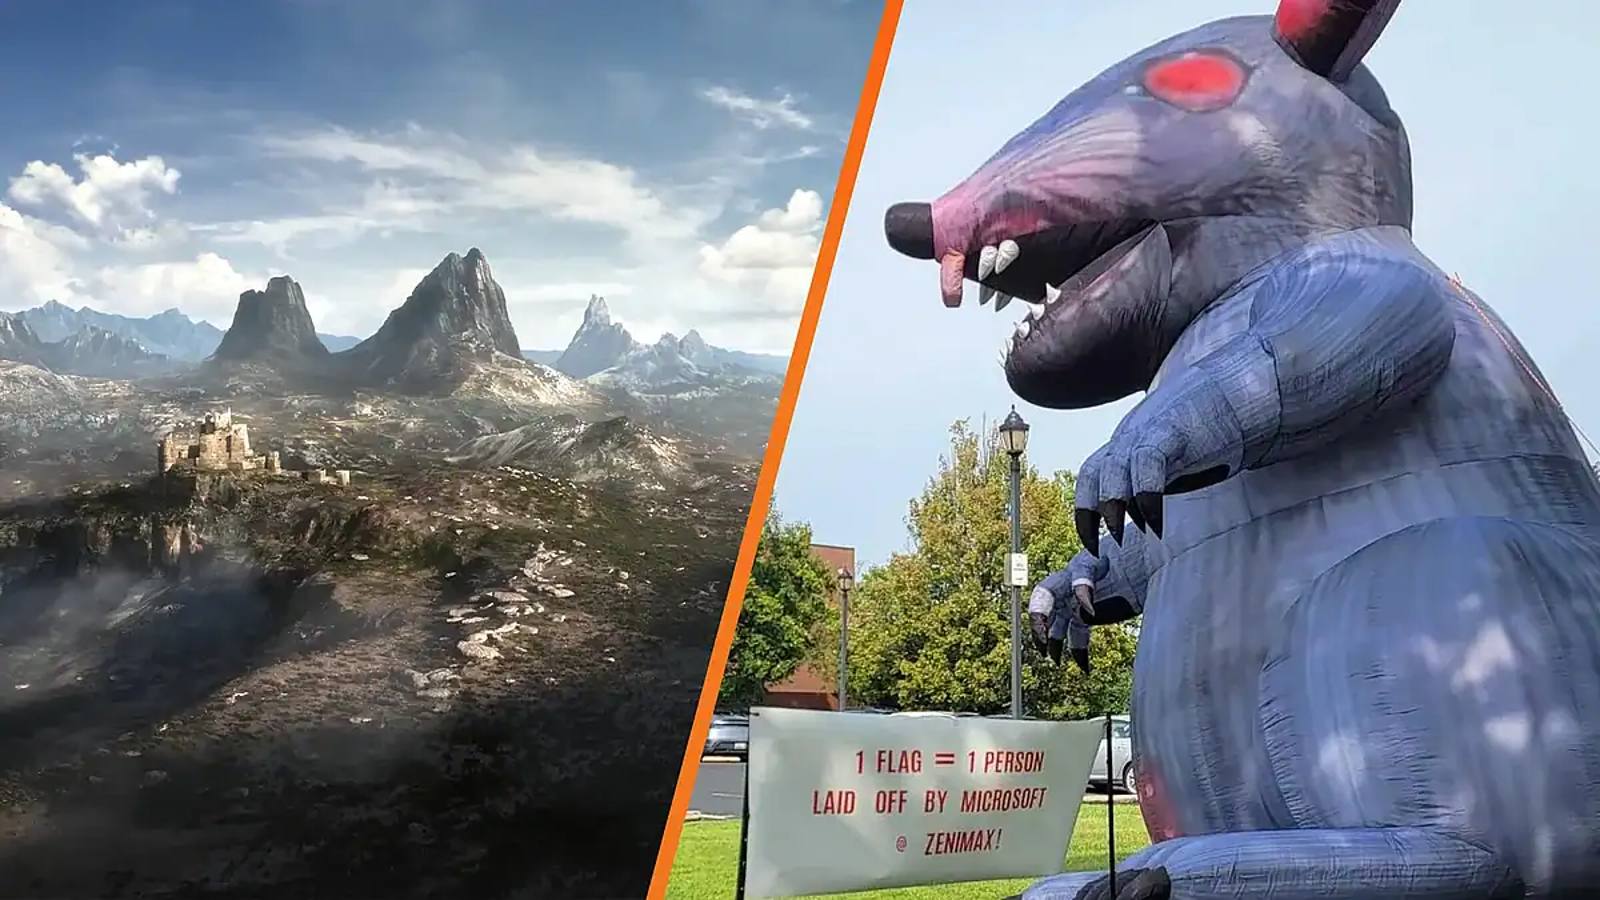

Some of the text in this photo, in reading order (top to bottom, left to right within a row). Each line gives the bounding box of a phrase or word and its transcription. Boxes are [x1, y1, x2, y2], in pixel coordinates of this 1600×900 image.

[855, 750, 1045, 775] 1 FLAG = 1 PERSON
[812, 786, 1048, 816] LAID OFF BY MICROSOFT
[924, 828, 1003, 856] ZENIMAX!
